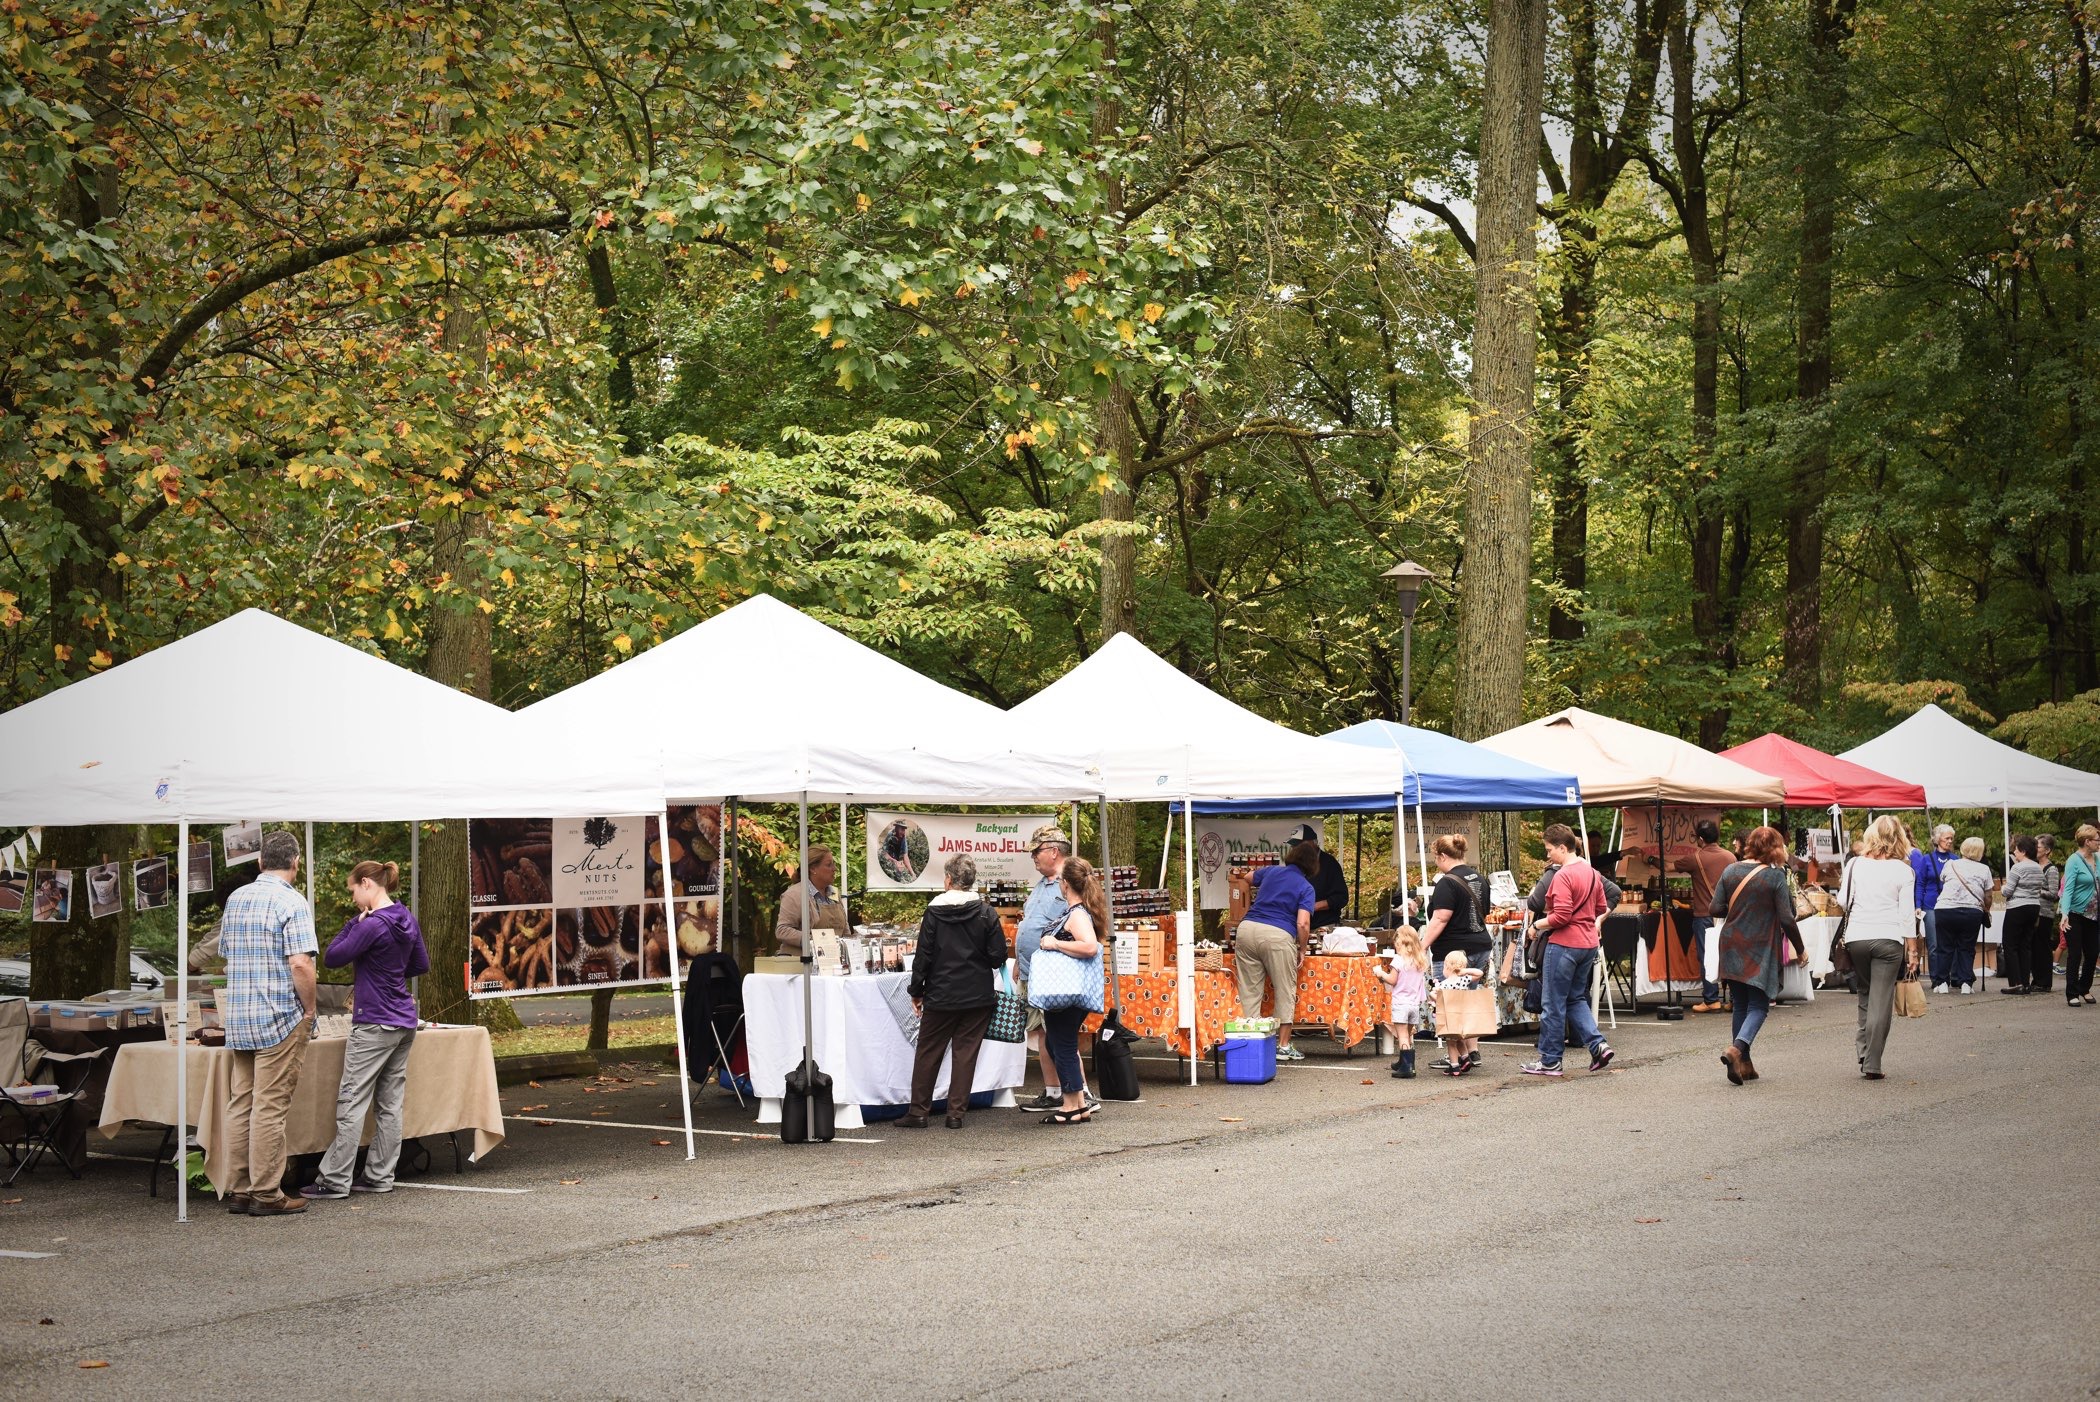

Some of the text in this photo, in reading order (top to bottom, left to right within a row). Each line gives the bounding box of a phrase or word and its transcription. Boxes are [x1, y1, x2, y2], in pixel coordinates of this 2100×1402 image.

[975, 823, 1018, 835] Backyard
[1404, 822, 1431, 834] Artan
[938, 836, 1030, 853] JAMS AND JELL
[562, 848, 634, 874] Mert's
[585, 874, 616, 883] NUTS
[688, 884, 716, 893] GOURMET
[472, 894, 497, 903] CLASSIC
[587, 972, 610, 980] SINFUL
[473, 980, 504, 989] PRETZELS
